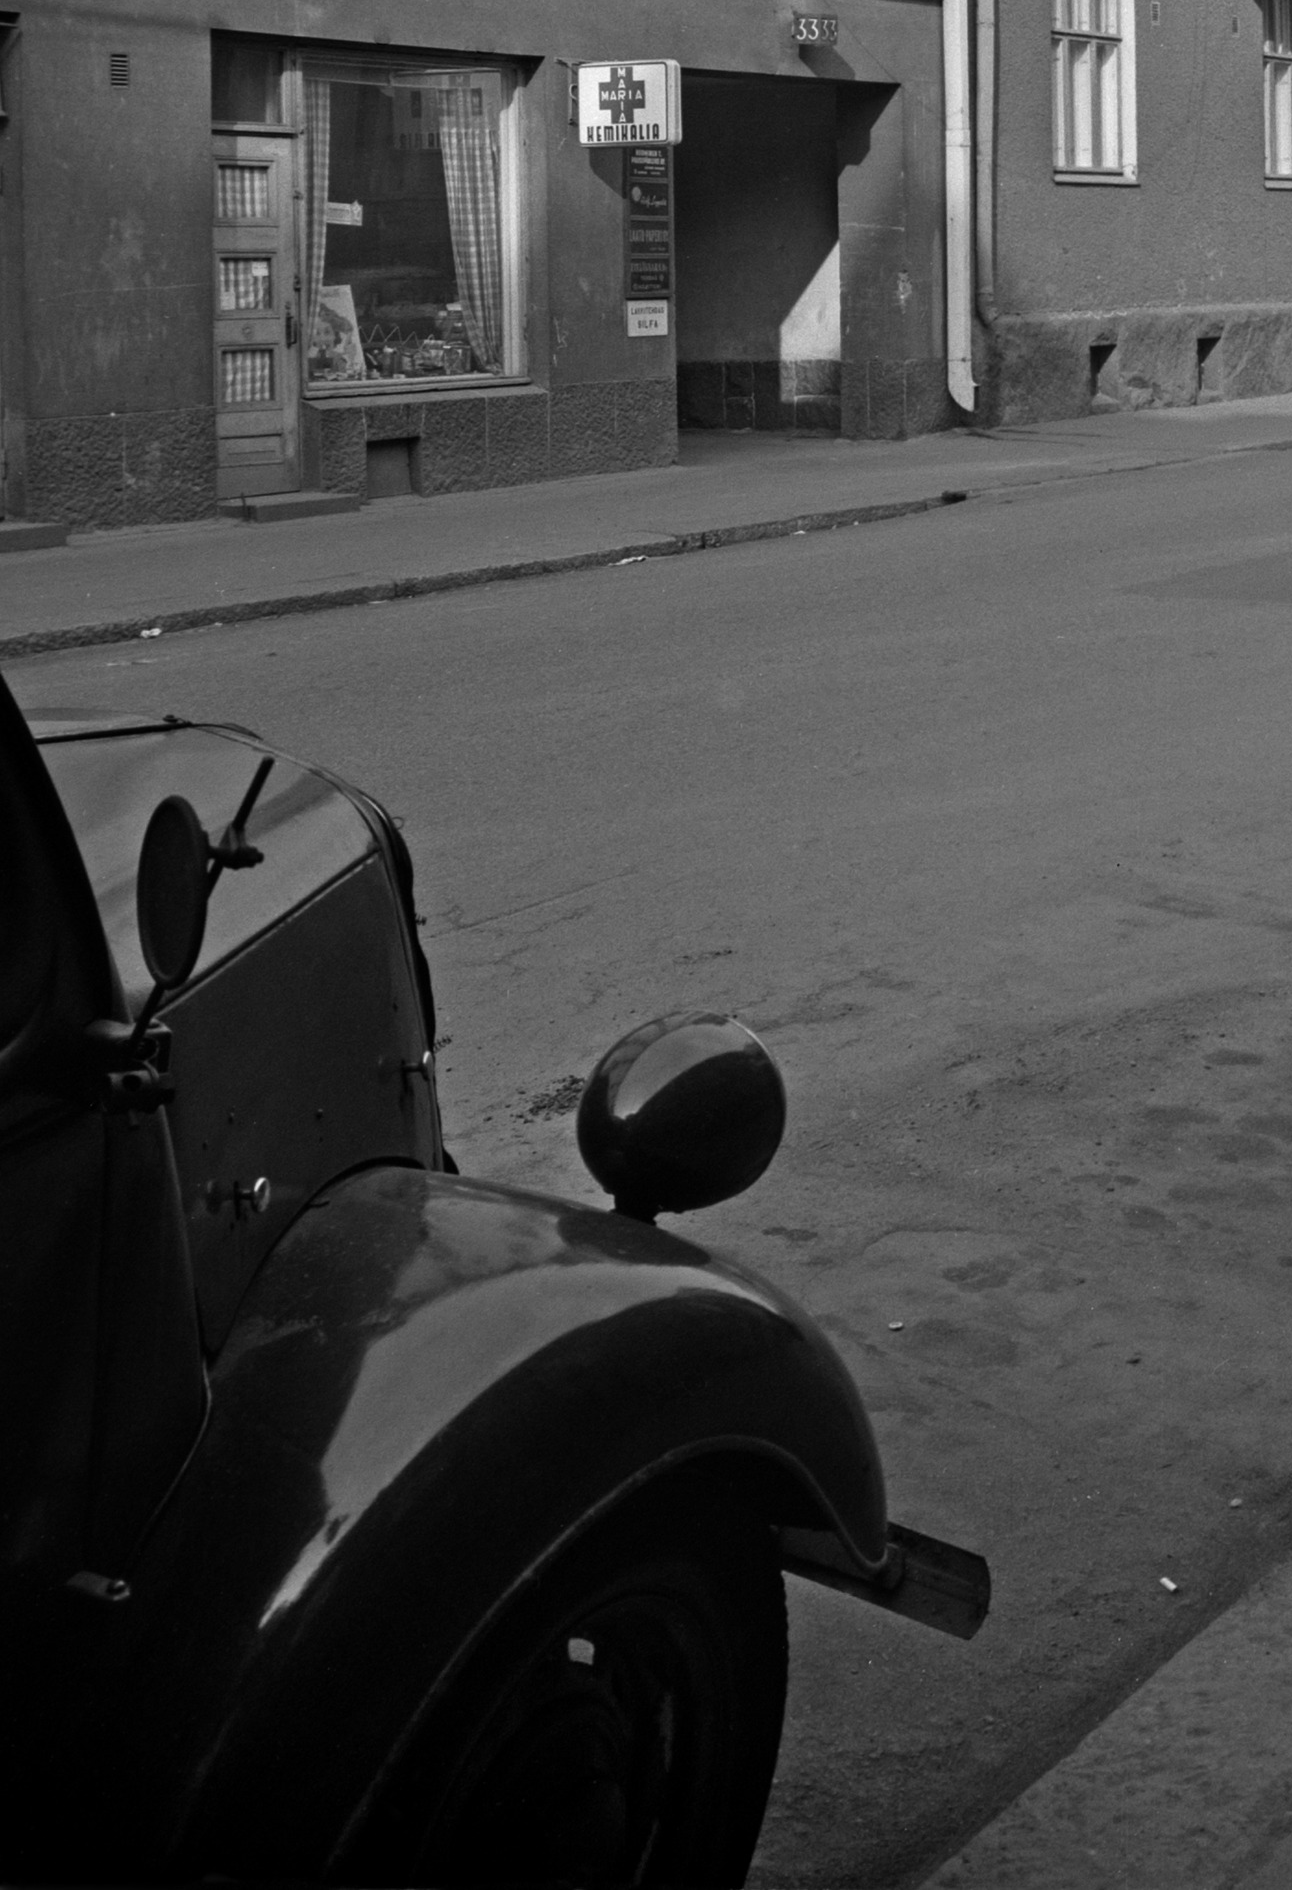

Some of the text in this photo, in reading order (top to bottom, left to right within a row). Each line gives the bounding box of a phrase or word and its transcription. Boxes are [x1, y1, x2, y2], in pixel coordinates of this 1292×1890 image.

[796, 18, 819, 40] 33
[601, 89, 643, 101] MARIA
[617, 67, 626, 123] MARIA
[587, 123, 660, 142] KEMIKALIA
